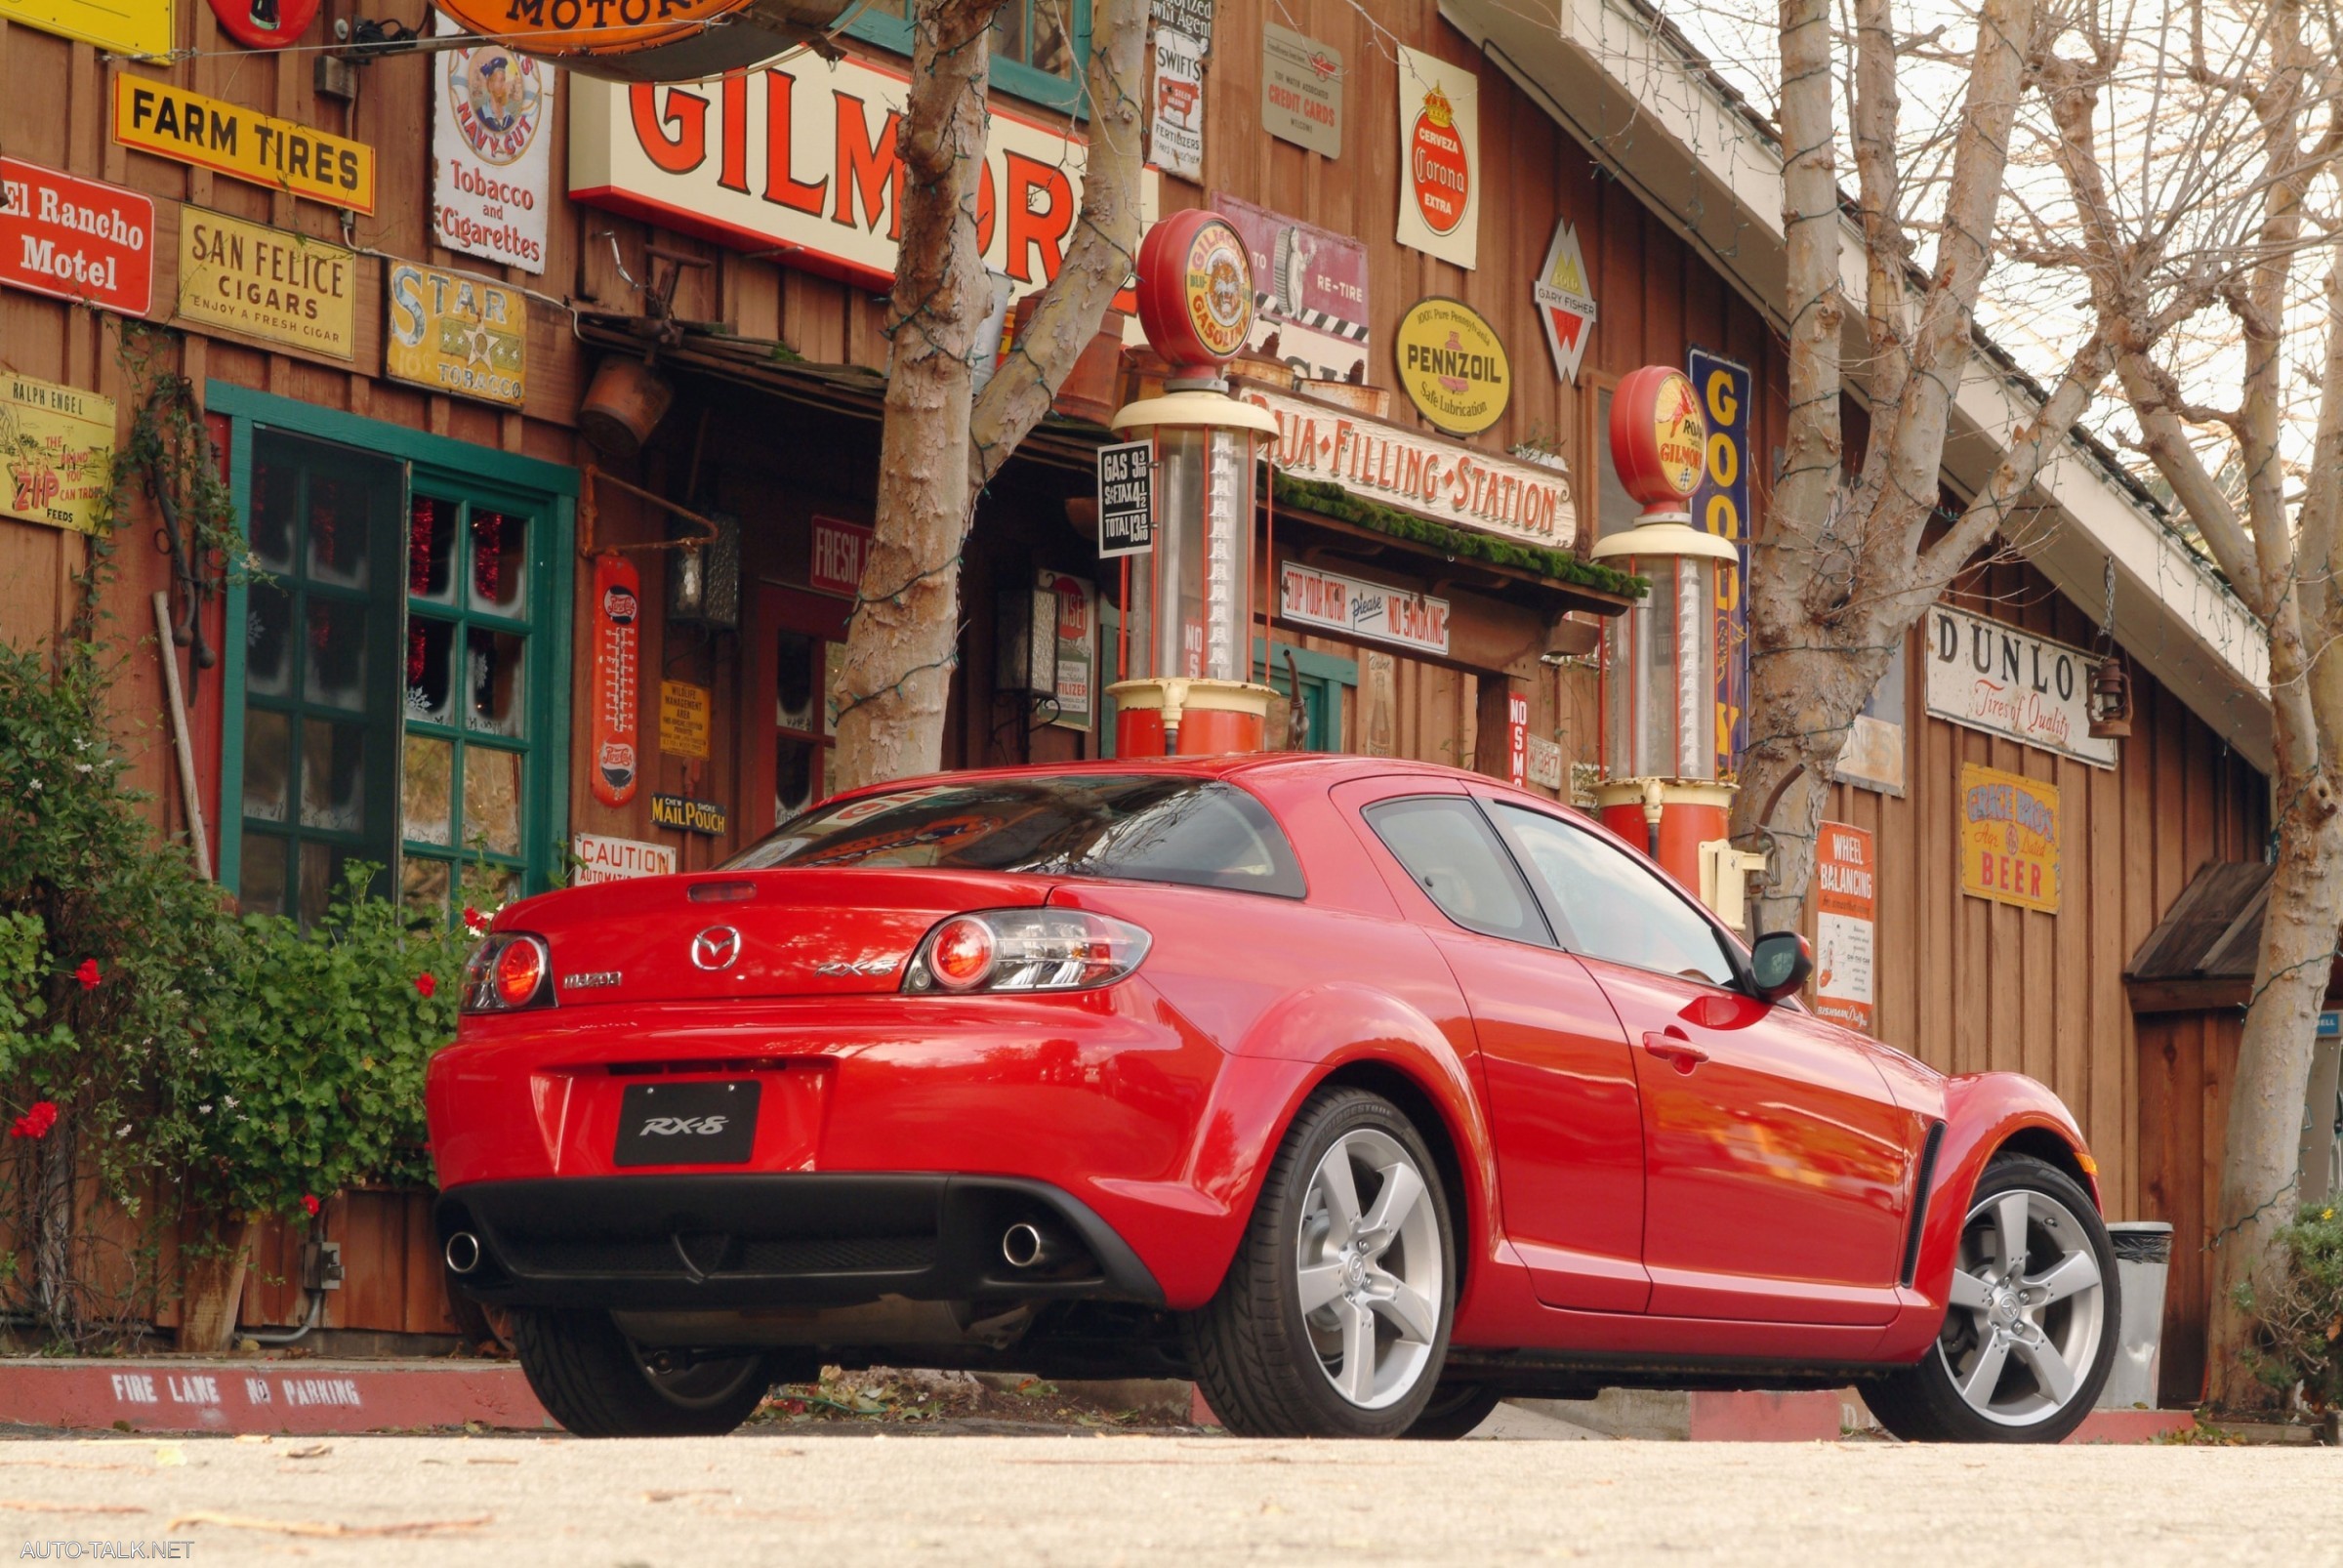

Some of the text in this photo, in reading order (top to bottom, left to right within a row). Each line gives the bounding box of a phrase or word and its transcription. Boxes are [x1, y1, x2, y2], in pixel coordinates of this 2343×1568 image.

[505, 0, 705, 30] MOTOR
[1176, 8, 1211, 38] Agent
[1157, 46, 1201, 81] SWIFT'S
[1268, 83, 1336, 128] CREDIT CARDS
[133, 88, 358, 191] FARM TIRES
[457, 102, 532, 157] NAVY CUT
[1418, 127, 1459, 154] CERVEZA
[450, 159, 534, 211] Tobacco
[1416, 146, 1464, 193] Corona
[629, 64, 1137, 316] GILMR
[1424, 192, 1452, 215] EXTRA
[0, 181, 144, 251] El Rancho
[482, 203, 503, 221] and
[442, 207, 540, 262] Cigarettes
[21, 234, 117, 291] Motel
[191, 225, 344, 299] SAN FELICE
[1253, 252, 1363, 303] TO RE-TIRE
[219, 274, 318, 320] CIGARS
[391, 266, 507, 348] STAR
[1539, 288, 1594, 316] GARY FISHER
[194, 297, 340, 343] ENJOY A FRESH CIGAR
[1434, 309, 1450, 320] Pure
[1451, 310, 1491, 347] Pennsylvania
[438, 361, 521, 399] TOBACCO
[1408, 344, 1501, 384] PENNZOIL
[13, 382, 83, 415] RALPH ENGEL
[1420, 381, 1488, 417] Safe Lubrication
[45, 436, 62, 448] THE
[66, 471, 82, 482] YOU
[1104, 453, 1128, 482] GAS
[1331, 419, 1439, 503] FILLING
[1454, 456, 1557, 535] STATION
[15, 470, 59, 512] ZIP
[60, 489, 76, 501] CAN
[47, 508, 73, 523] FEEDS
[1105, 517, 1130, 538] TOTAL
[815, 525, 858, 584] FRESH
[1058, 591, 1089, 631] NSET
[1286, 570, 1303, 612] STOP
[1304, 574, 1323, 617] YOUR
[1324, 579, 1346, 623] MOTOR
[1388, 595, 1401, 635] NO
[1403, 598, 1445, 645] SMOKING
[1184, 624, 1203, 653] NO
[1937, 613, 2099, 707] DUNLO
[665, 694, 702, 712] MANAGEMENT
[1510, 698, 1527, 725] NO
[1974, 679, 2071, 744] Tires of Quality
[665, 797, 716, 812] CHEW SMOKE
[1967, 784, 2014, 823] GRACE
[583, 840, 669, 875] CAUTION
[1832, 833, 1864, 865] WHEEL
[580, 869, 632, 883] AUTOMAT
[1820, 863, 1871, 899] BALANCING
[1982, 851, 2041, 897] BEER
[814, 959, 901, 977] RX-8
[638, 1114, 729, 1135] RX-8
[111, 1375, 361, 1406] FIRE LANE NO PARKING
